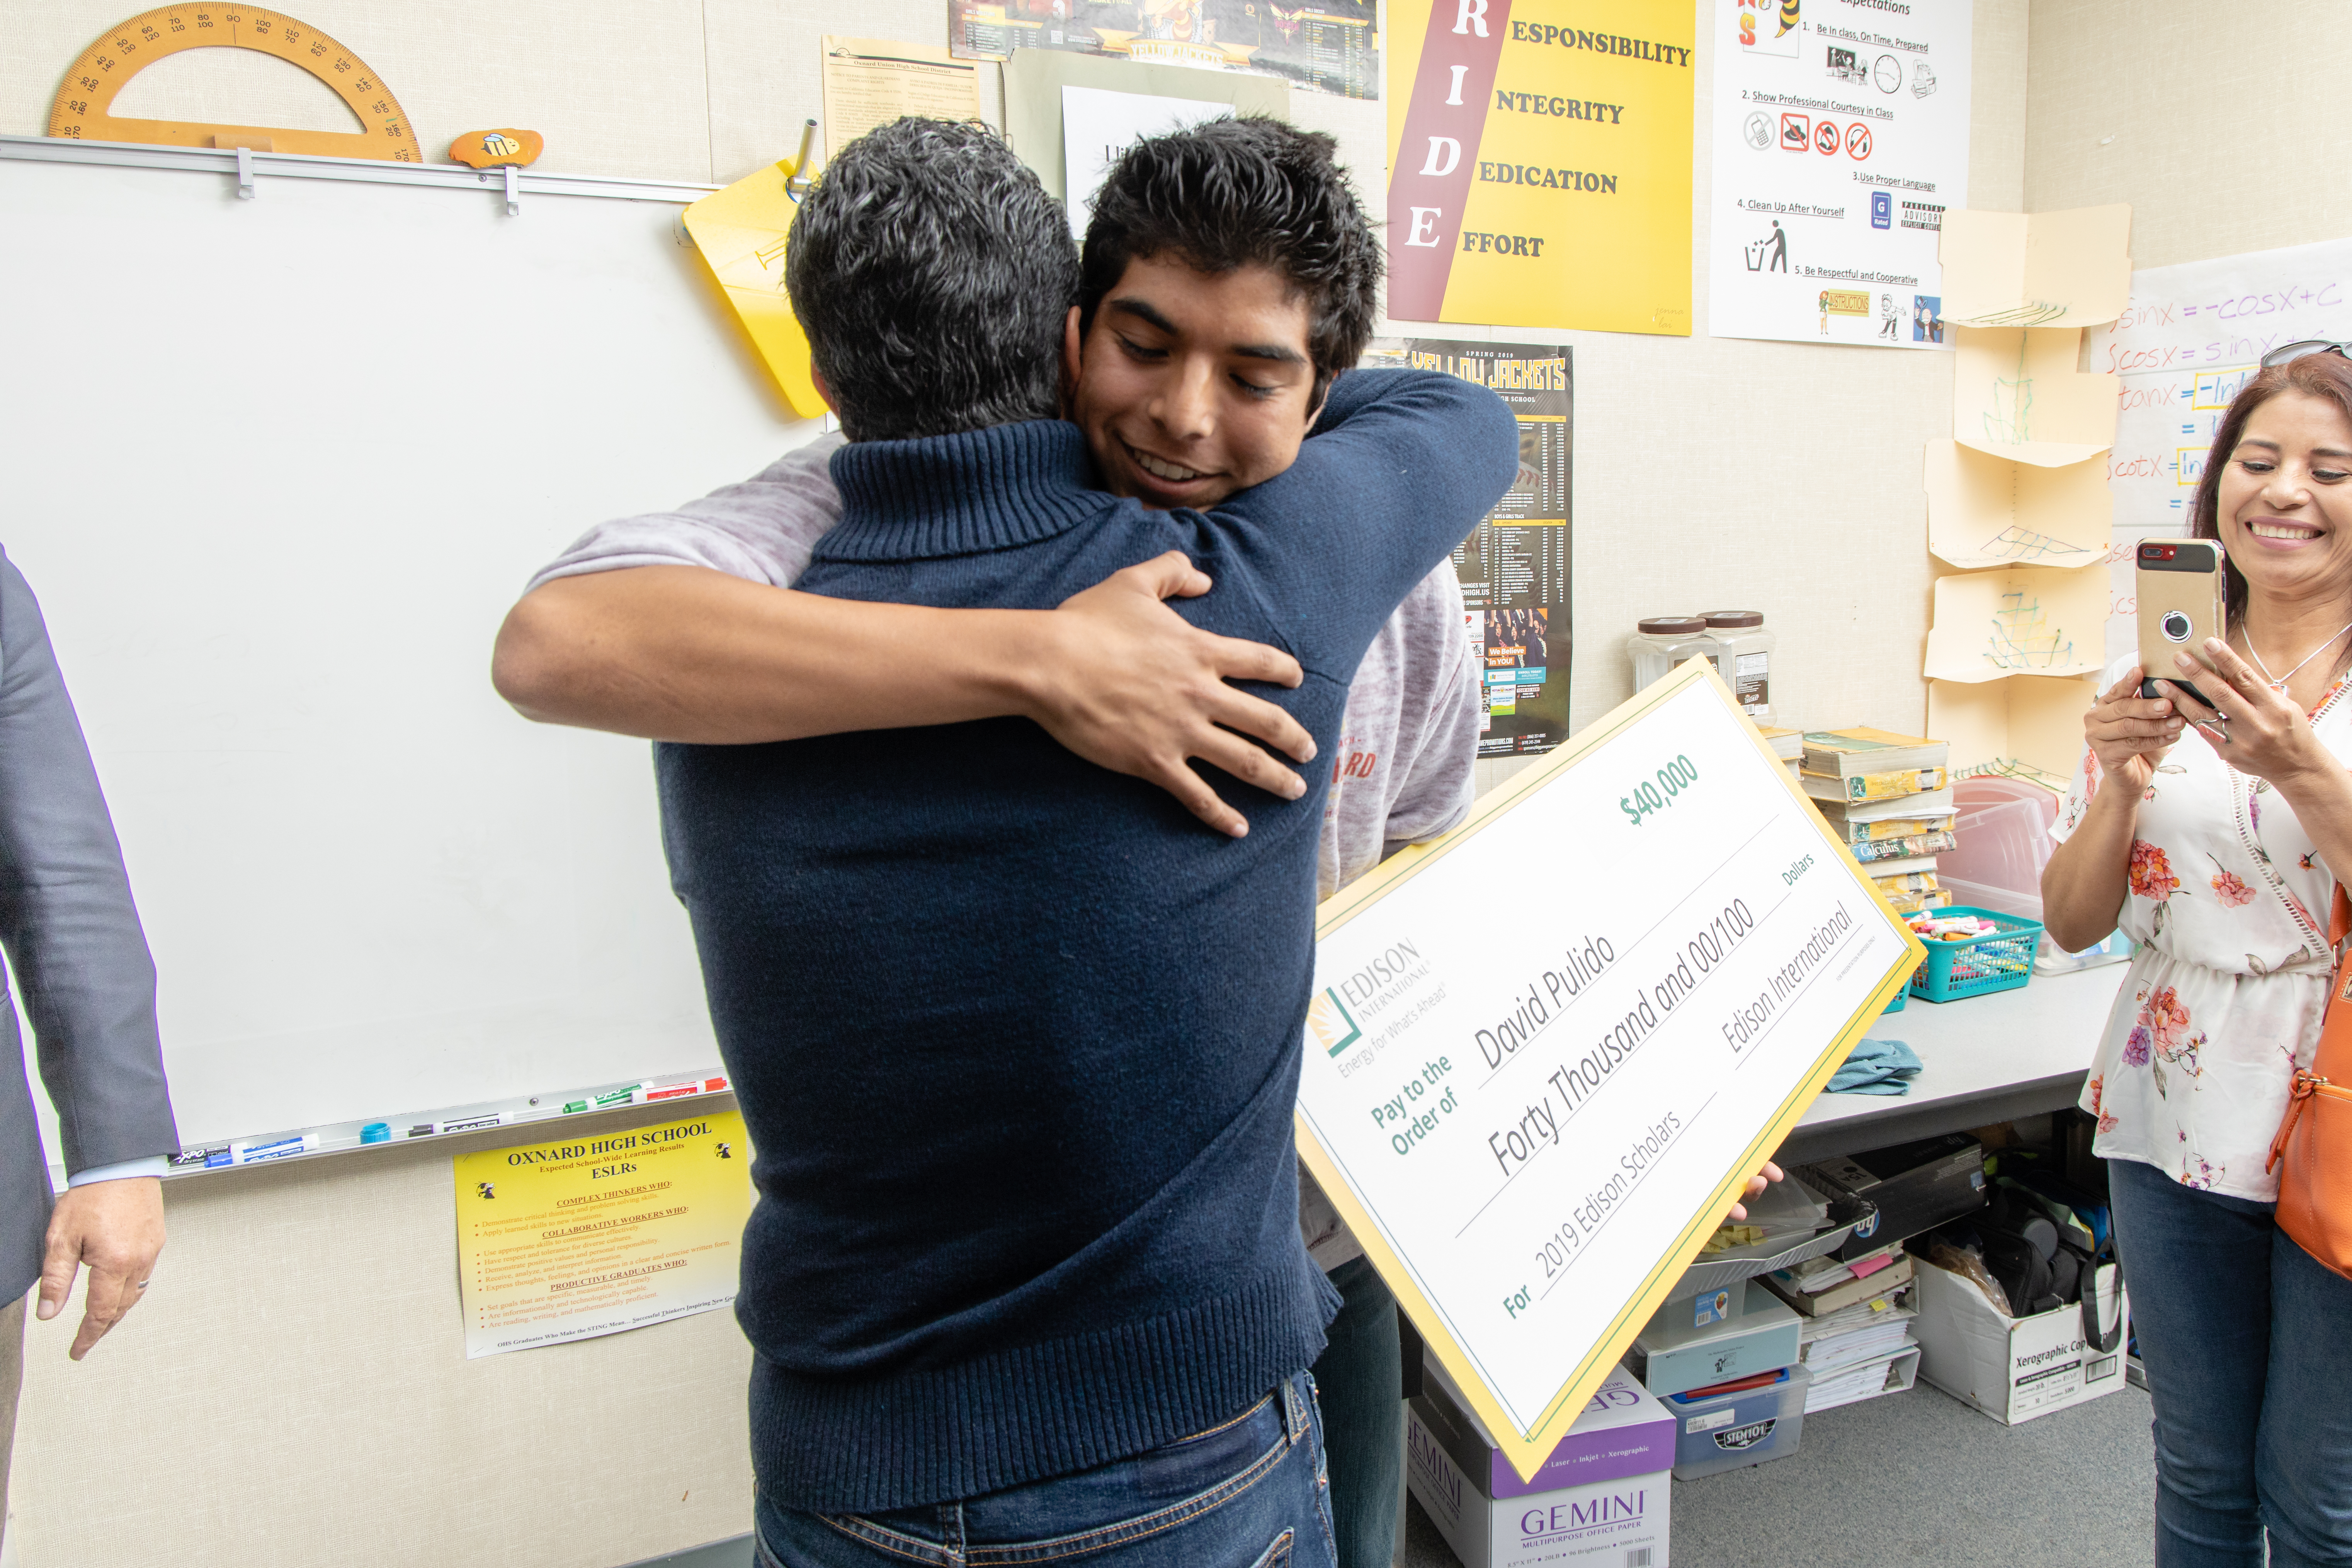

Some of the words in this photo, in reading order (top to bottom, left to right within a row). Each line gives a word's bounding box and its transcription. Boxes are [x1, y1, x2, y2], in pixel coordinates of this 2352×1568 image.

[145, 32, 160, 42] 120
[171, 24, 185, 32] 110
[255, 19, 271, 27] 100
[286, 29, 299, 37] 110
[1452, 0, 1490, 38] R
[1511, 20, 1691, 67] ESPONSIBILITY
[1803, 22, 1810, 31] 1.
[1817, 24, 1828, 34] Be
[1829, 26, 1837, 35] In
[1838, 27, 1859, 41] class,
[1861, 32, 1872, 42] On
[1873, 34, 1893, 47] Time,
[1896, 38, 1928, 52] Prepared
[337, 58, 351, 70] 130
[1131, 44, 1223, 66] YELLOWJACKETS
[1445, 65, 1469, 105] I
[1497, 90, 1624, 124] NTEGRITY
[1742, 90, 1750, 99] 2.
[1752, 91, 1776, 102] Show
[1779, 94, 1829, 109] Professional
[1831, 100, 1865, 115] Courtesy
[1867, 106, 1874, 114] in
[1876, 107, 1893, 118] Class
[1419, 136, 1461, 177] D
[1479, 162, 1617, 195] EDICATION
[1876, 175, 1901, 187] Proper
[1903, 177, 1936, 190] Language
[1738, 199, 1745, 209] 4.
[1748, 200, 1772, 210] Clean
[1774, 202, 1786, 214] Up
[1788, 203, 1809, 214] After
[1812, 205, 1845, 217] Yourself
[1878, 202, 1885, 213] G
[1905, 202, 1943, 212] PARENTAL
[1405, 206, 1442, 248] E
[1463, 232, 1544, 257] FFORT
[1902, 220, 1922, 229] EXPLICIT
[1795, 266, 1803, 275] 5.
[1805, 266, 1816, 276] Be
[1818, 267, 1858, 280] Respectful
[1860, 271, 1874, 281] and
[1876, 272, 1918, 286] Cooperative
[1829, 293, 1869, 310] INSTRUCTIONS
[1488, 357, 1565, 390] JACKETS
[1620, 754, 1698, 827] $40,000
[1860, 842, 1900, 857] Calculus
[1782, 852, 1815, 886] Dollars
[1340, 937, 1420, 1007] EDISON
[1841, 955, 1859, 976] PRESENTATION
[1857, 942, 1870, 957] PURPOSES
[1721, 991, 1775, 1053] Edison
[1767, 900, 1852, 1002] International
[1474, 986, 1551, 1070] David
[1542, 935, 1614, 1014] Pulido
[1338, 1046, 1374, 1078] Energy
[1371, 1034, 1388, 1051] for
[1385, 1010, 1419, 1039] What's
[1416, 985, 1446, 1016] Ahead
[1488, 1097, 1561, 1177] Forty
[1548, 990, 1658, 1104] Thousand
[1655, 952, 1696, 1012] and
[1689, 898, 1754, 973] 00/100
[1371, 1093, 1407, 1130] Pay
[1402, 1078, 1425, 1103] to
[1422, 1056, 1452, 1084] the
[1391, 1112, 1440, 1156] Order
[1439, 1086, 1459, 1114] of
[508, 1145, 585, 1166] OXNARD
[590, 1136, 637, 1155] HIGH
[641, 1122, 712, 1146] SCHOOL
[540, 1162, 574, 1173] Expected
[576, 1154, 622, 1168] School-Wide
[624, 1148, 657, 1159] Learning
[659, 1143, 685, 1153] Results
[592, 1163, 637, 1179] ESLRs
[557, 1194, 600, 1207] COMPLEX
[602, 1185, 647, 1199] THINKERS
[649, 1181, 673, 1191] WHO:
[1535, 1223, 1580, 1279] 2019
[1573, 1171, 1628, 1233] Edison
[1620, 1110, 1680, 1180] Scholars
[542, 1219, 618, 1238] COLLABORATIVE
[621, 1211, 663, 1223] WORKERS
[666, 1206, 689, 1215] WHO:
[551, 1275, 608, 1291] PRODUCTIVE
[610, 1264, 662, 1279] GRADUATES
[664, 1259, 688, 1269] WHO:
[1502, 1283, 1532, 1320] For
[513, 1336, 543, 1345] Graduates
[587, 1323, 608, 1332] STING
[633, 1312, 660, 1323] Successful
[661, 1307, 685, 1317] Thinkers
[687, 1301, 711, 1311] Inspiring
[2016, 1344, 2068, 1368] Xerographic
[1726, 1424, 1765, 1444] STEM101
[1551, 1458, 1570, 1468] Laser
[1579, 1454, 1599, 1464] Inkjet
[1608, 1445, 1650, 1459] Xerographic
[1521, 1490, 1644, 1535] GEMINI
[1522, 1532, 1584, 1549] MULTIPURPOSE
[1587, 1526, 1615, 1537] OFFICE
[1618, 1521, 1641, 1531] PAPER
[1578, 1544, 1611, 1555] Brightness
[1634, 1536, 1655, 1544] Sheets
